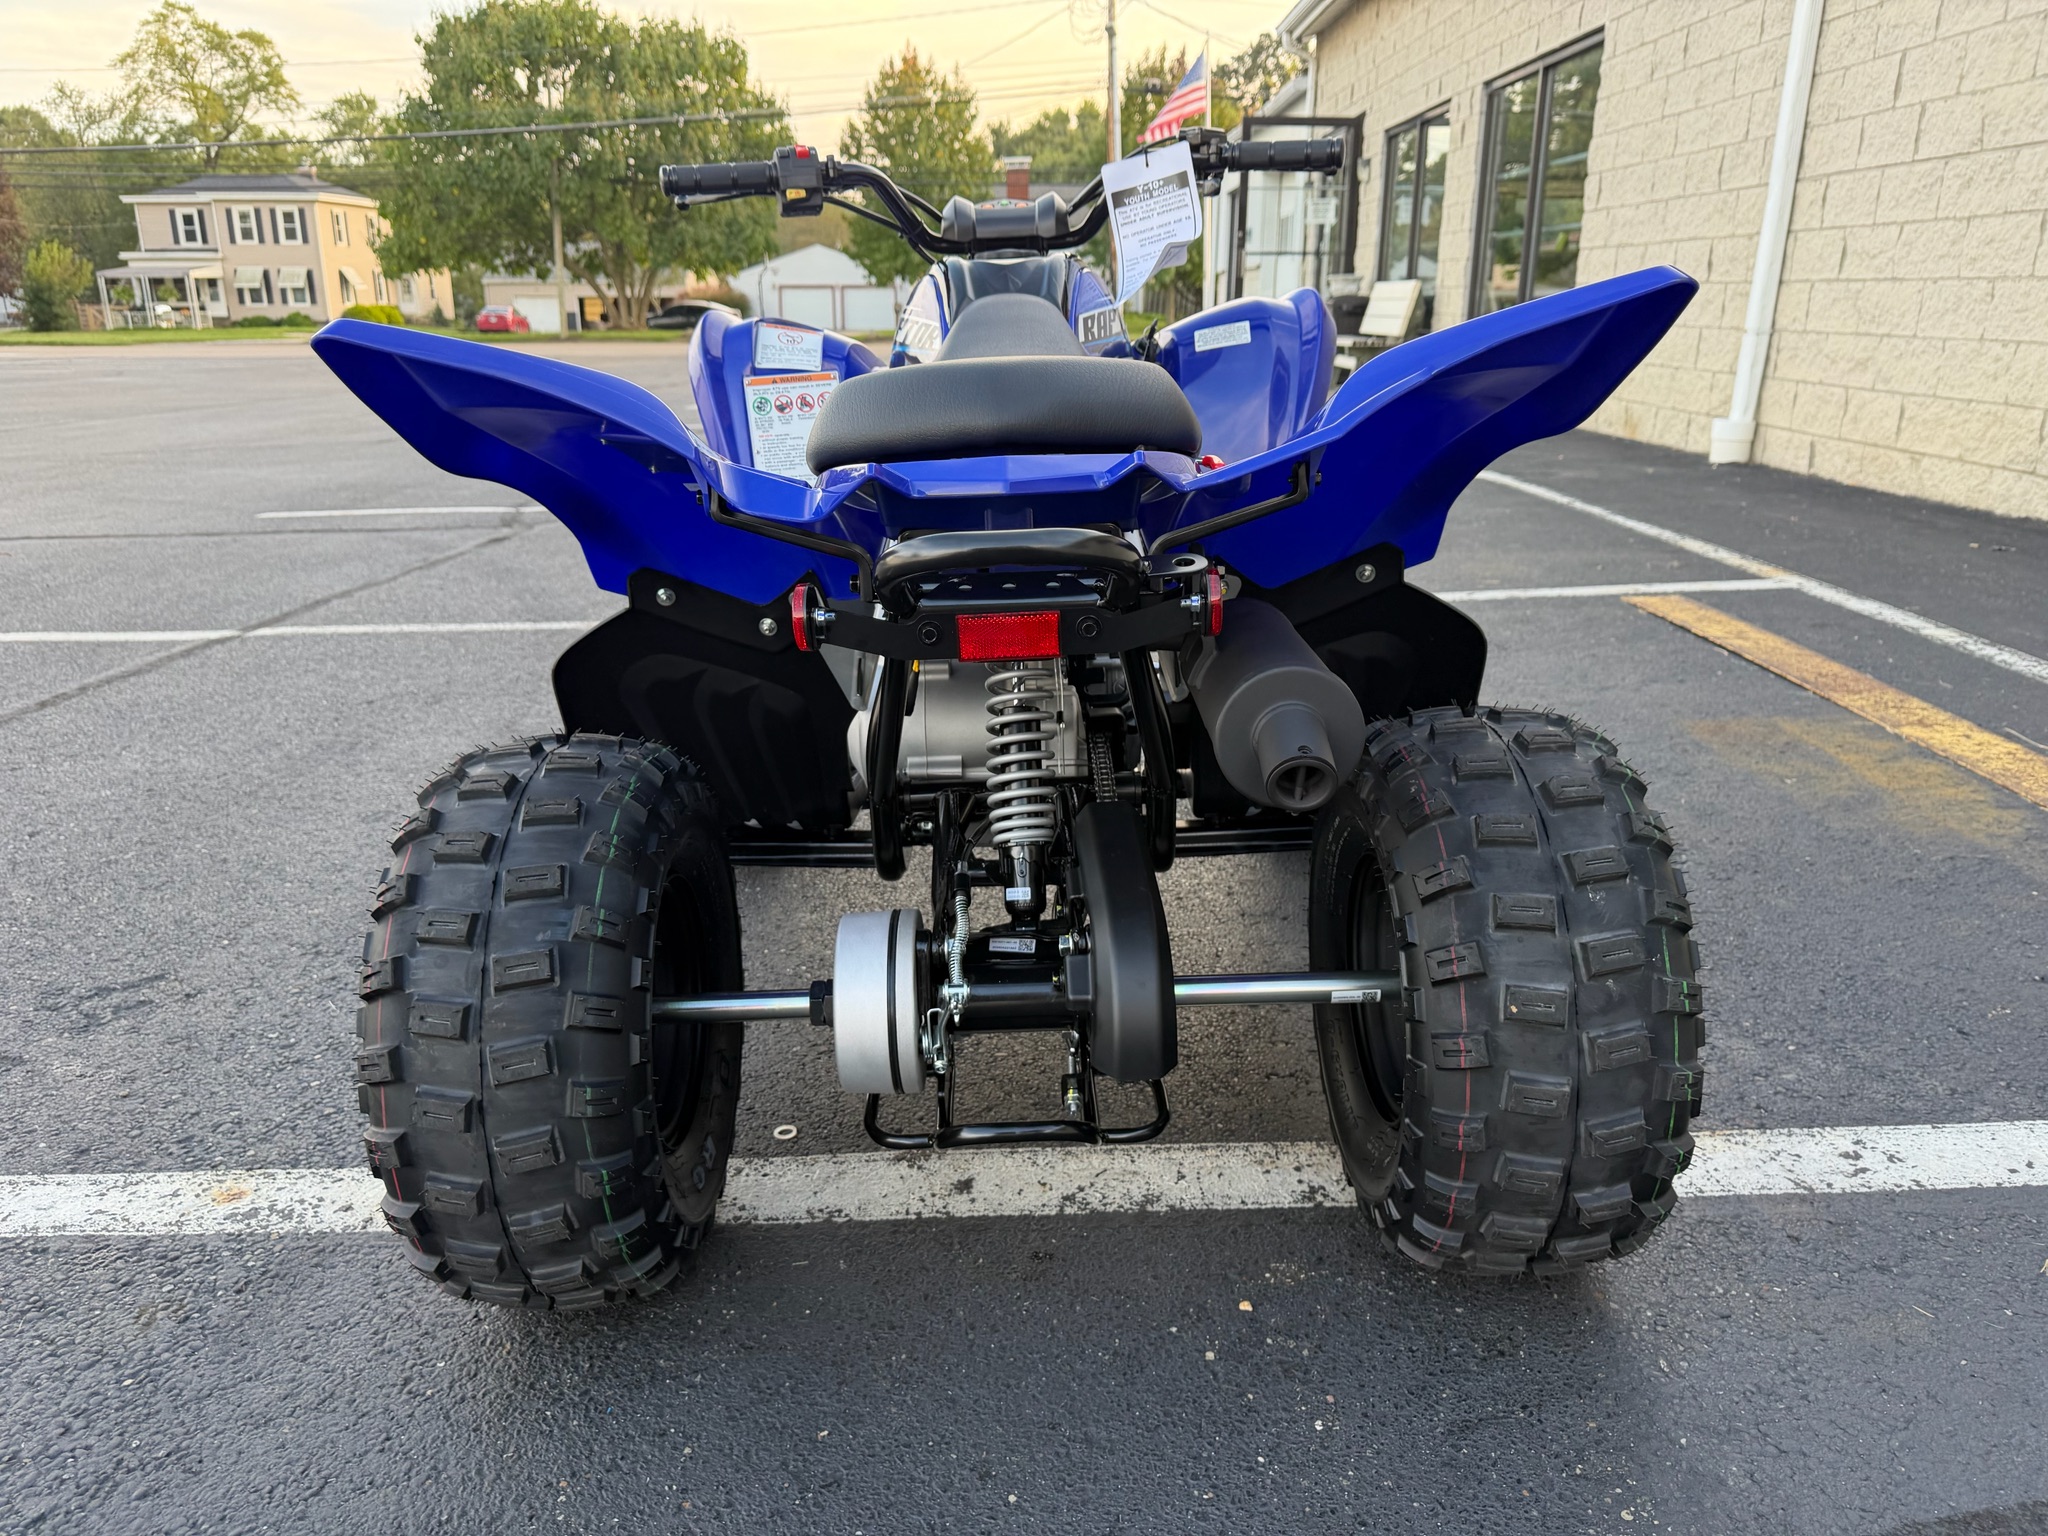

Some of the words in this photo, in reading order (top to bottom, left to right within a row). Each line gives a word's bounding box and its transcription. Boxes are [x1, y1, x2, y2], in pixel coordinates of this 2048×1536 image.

[1123, 193, 1151, 206] YOUTH
[1152, 183, 1179, 199] MODEL
[1129, 206, 1139, 214] ATV
[779, 375, 813, 384] WARNING
